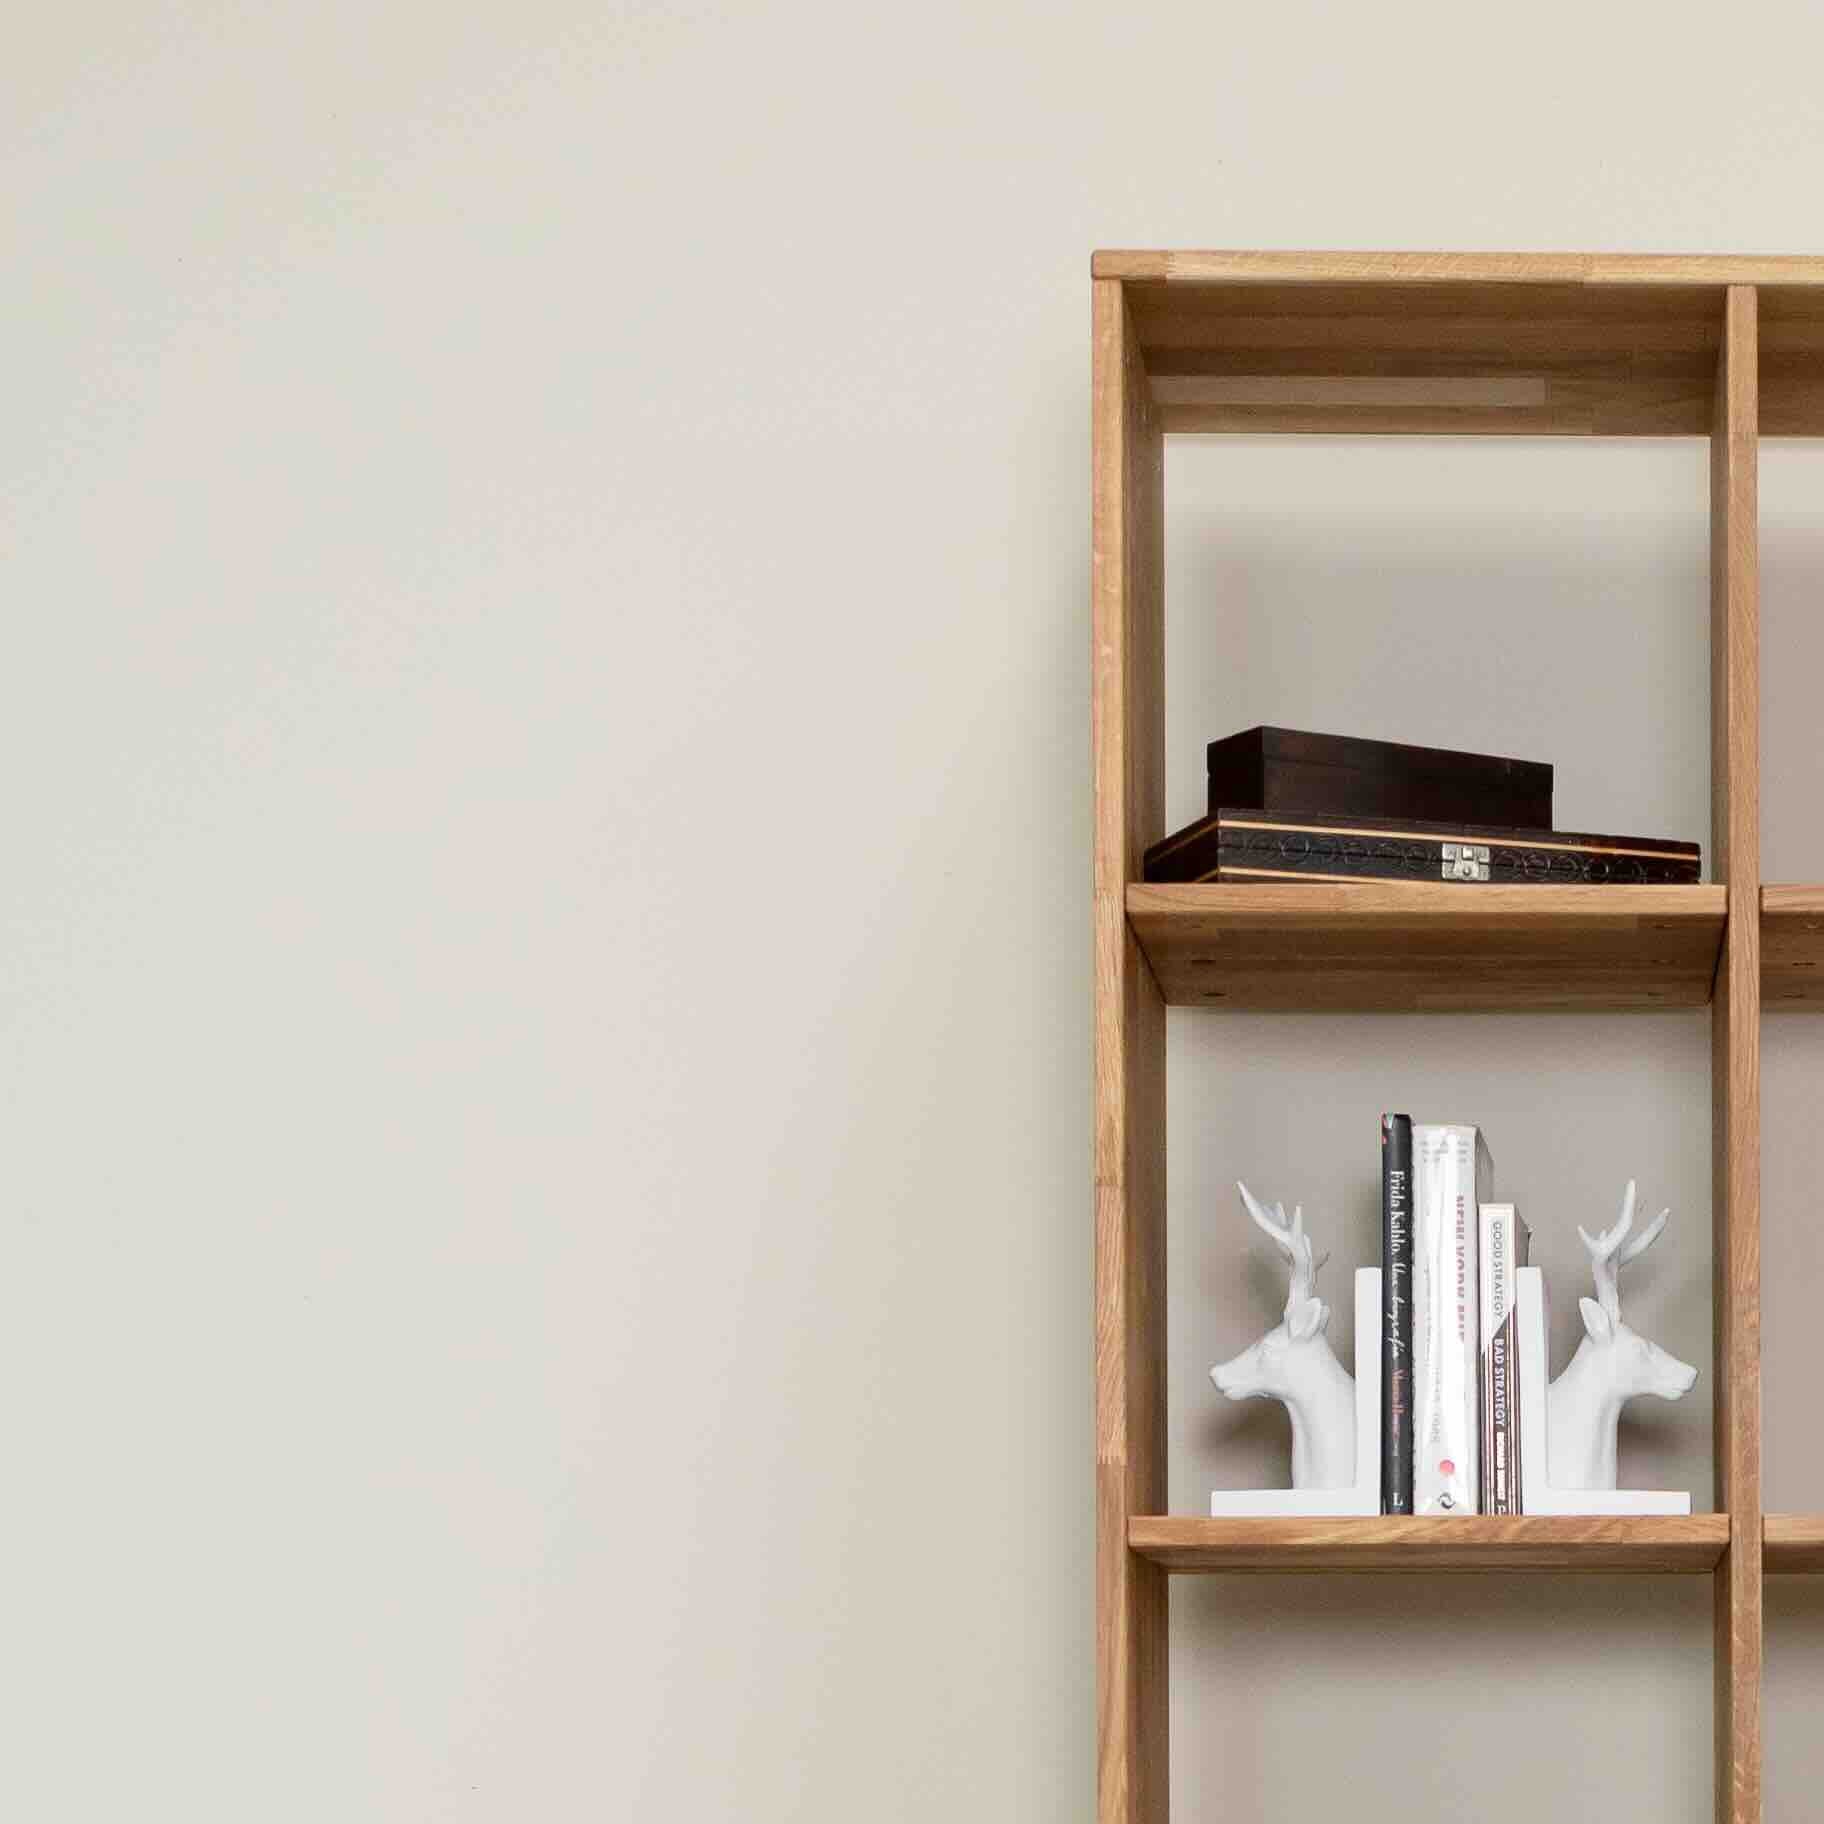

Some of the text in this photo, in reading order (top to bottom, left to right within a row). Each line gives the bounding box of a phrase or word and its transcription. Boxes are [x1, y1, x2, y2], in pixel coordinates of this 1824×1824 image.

[1390, 1170, 1405, 1208] Frida
[1390, 1210, 1405, 1256] Kahlo.
[1493, 1221, 1504, 1319] GOOD STRATEGY
[1494, 1338, 1506, 1427] BAD STRATEGY
